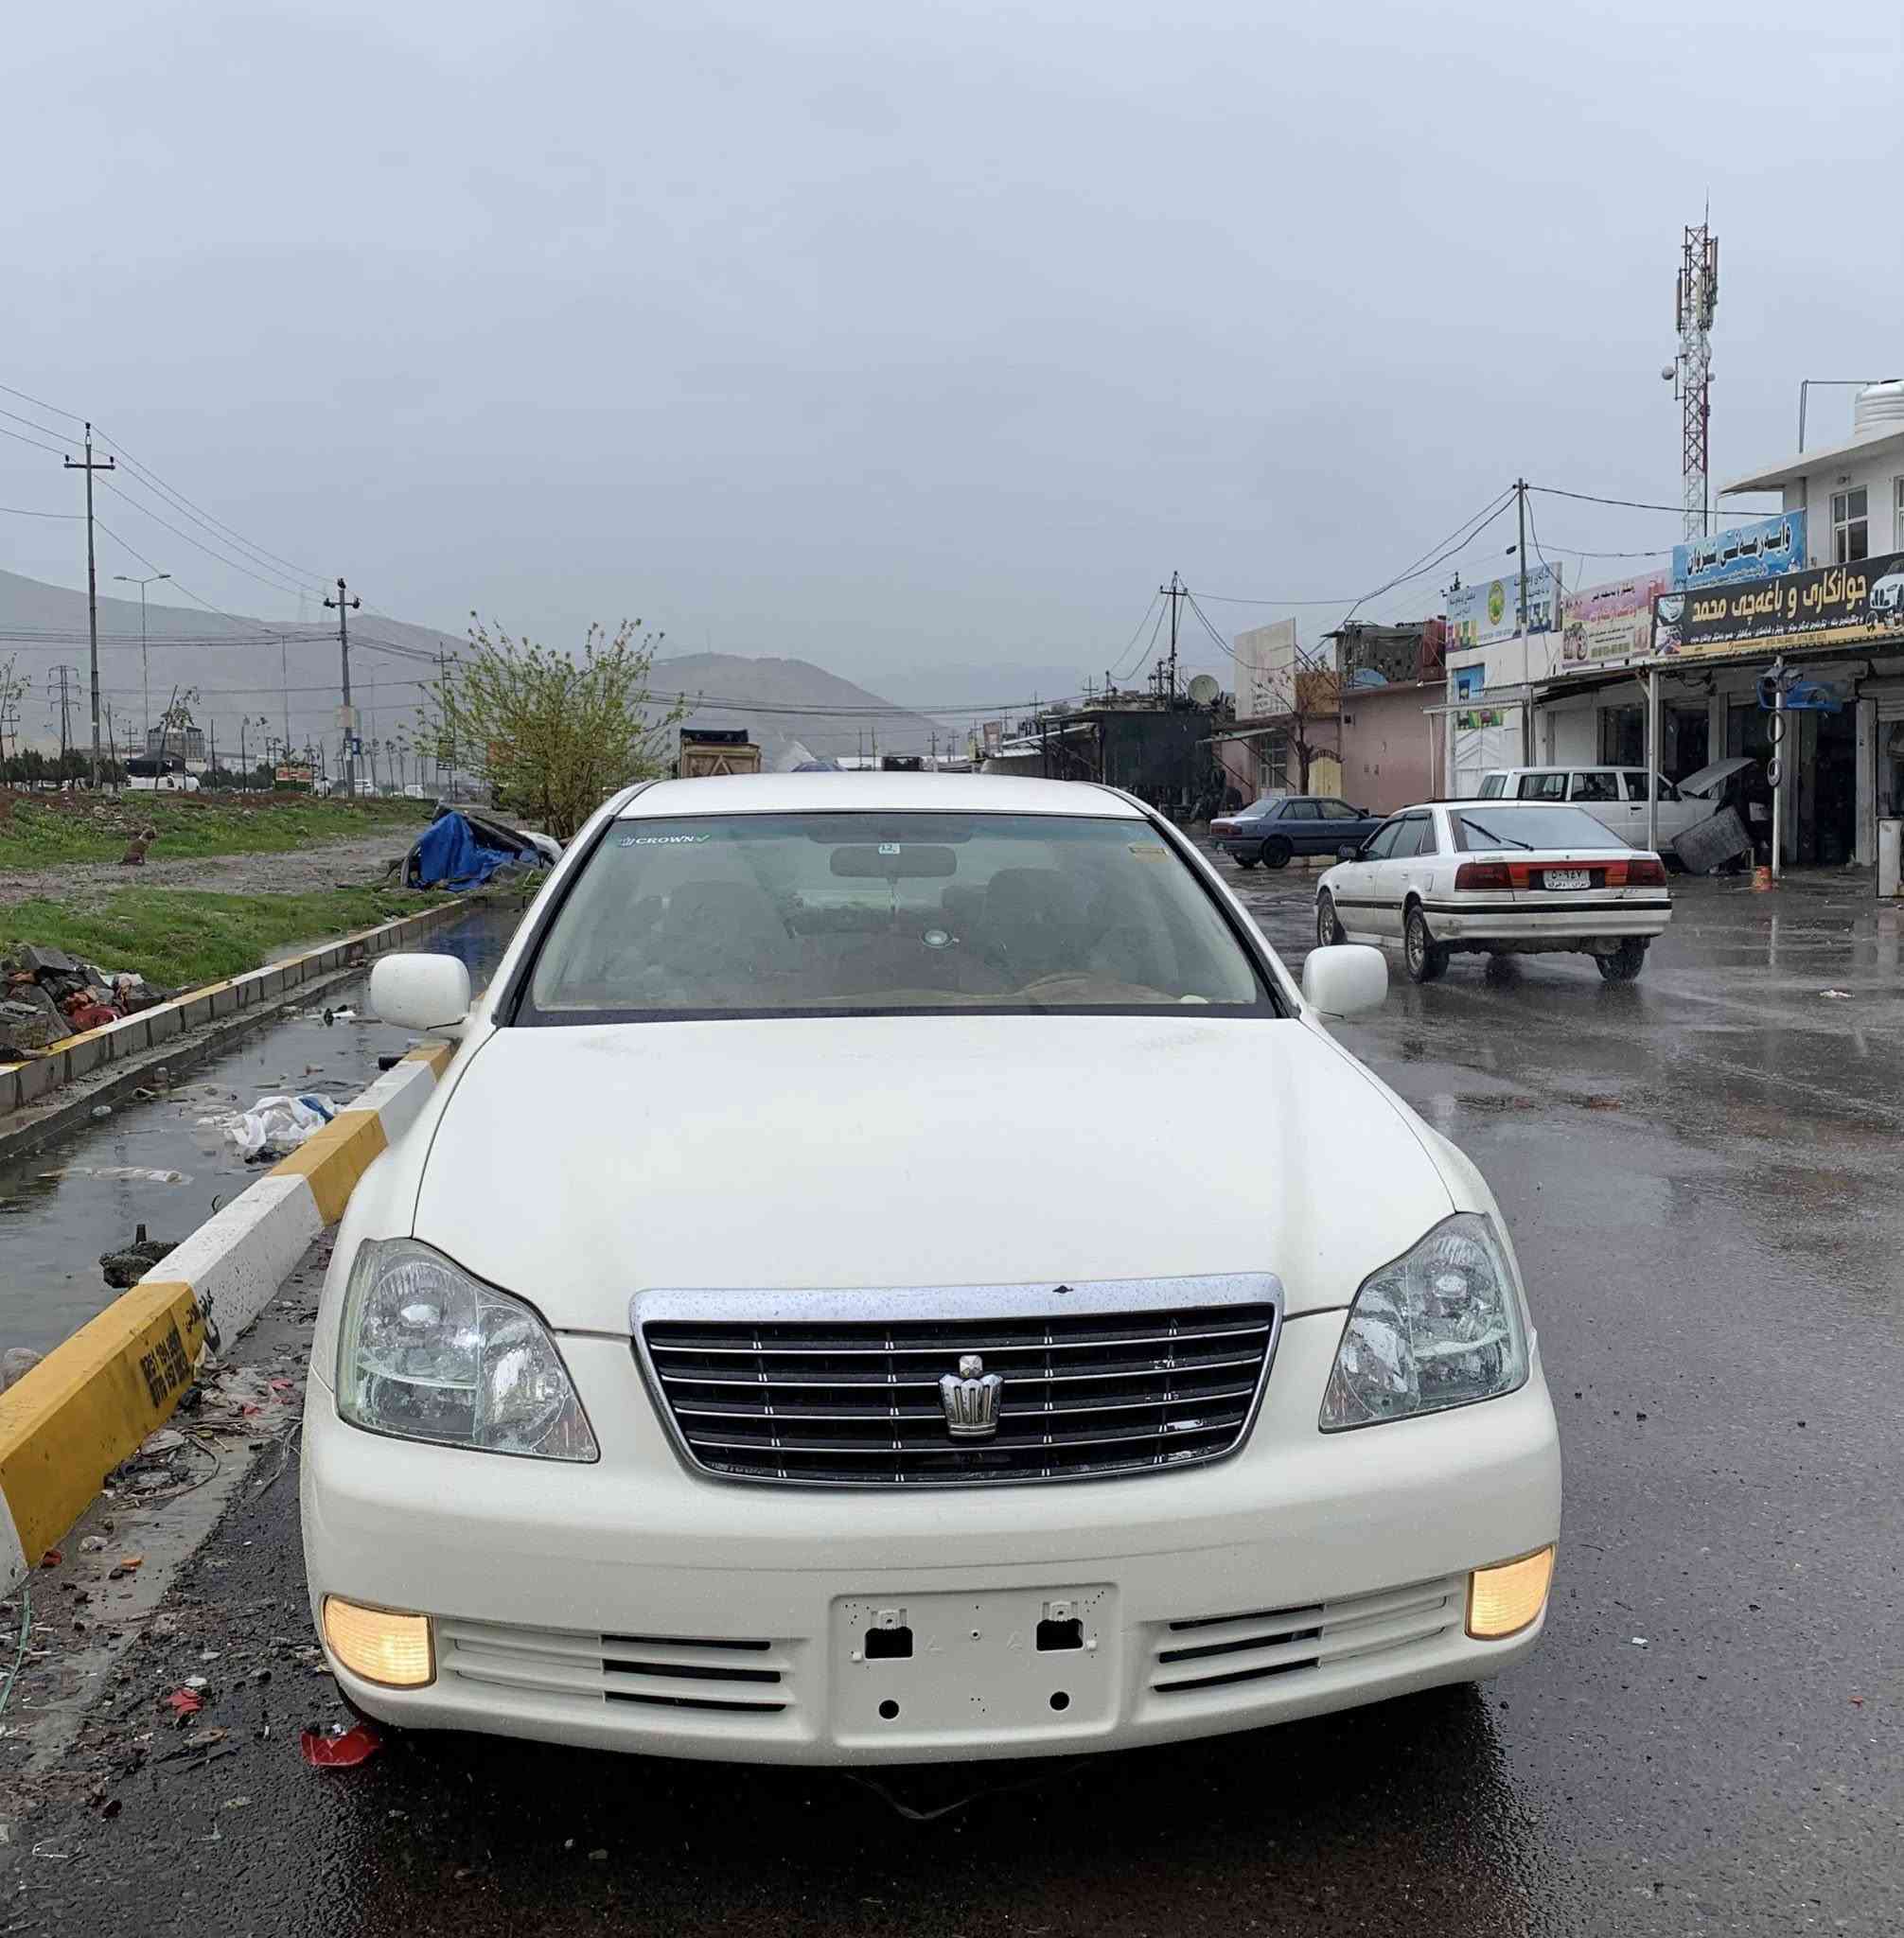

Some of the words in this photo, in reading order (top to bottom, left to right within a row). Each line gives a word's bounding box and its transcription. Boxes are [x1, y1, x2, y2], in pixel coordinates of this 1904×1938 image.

[1692, 597, 1727, 623] محمد
[1787, 586, 1798, 618] و
[635, 836, 694, 845] CROWN
